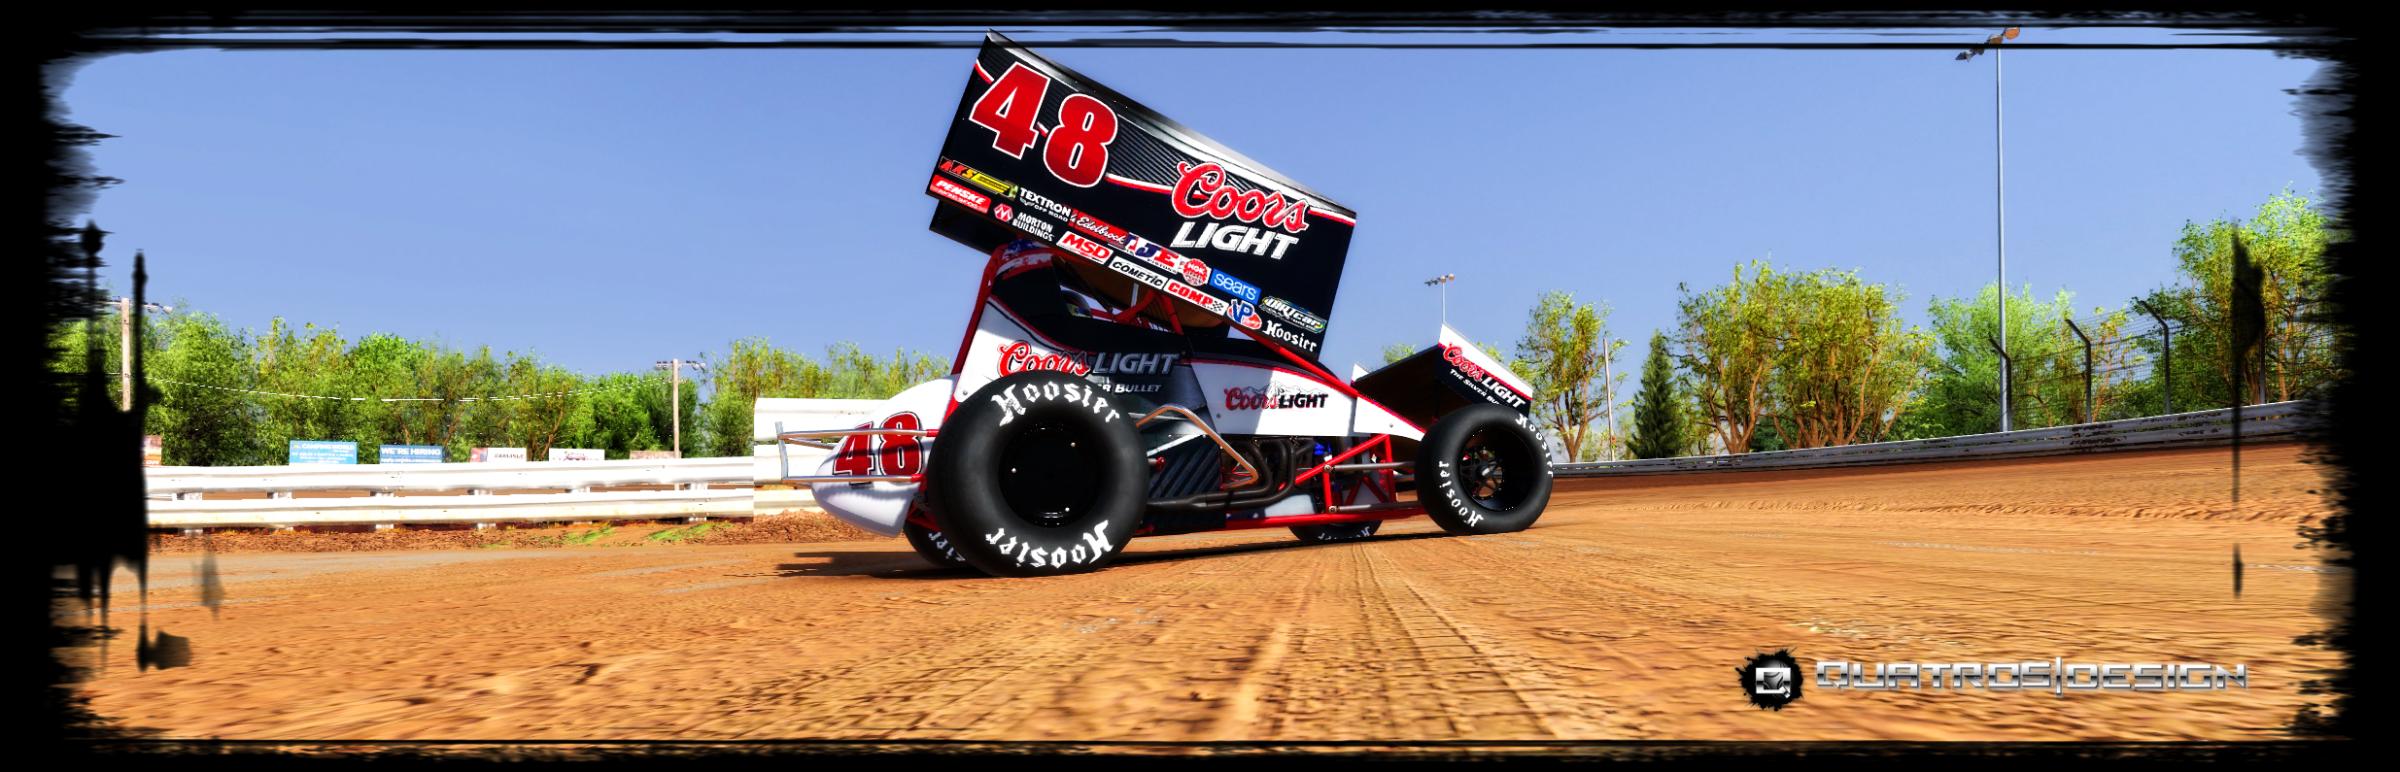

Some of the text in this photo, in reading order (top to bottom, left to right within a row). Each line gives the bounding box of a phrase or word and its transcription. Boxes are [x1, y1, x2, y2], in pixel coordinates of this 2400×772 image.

[968, 60, 1118, 188] 48
[936, 180, 986, 204] PENSKE
[1020, 187, 1072, 217] TEXTRON
[1172, 160, 1309, 233] Coors
[1012, 219, 1055, 242] BUILDINGS
[1018, 212, 1053, 232] MORTON
[1076, 214, 1126, 245] Edelbrock
[1062, 233, 1111, 260] MSD
[1170, 221, 1300, 260] LIGHT
[1168, 281, 1213, 307] COMP
[1213, 273, 1256, 301] sears
[1231, 300, 1254, 324] VP
[1262, 320, 1317, 352] Hoosier
[998, 340, 1180, 377] Coors LIGHT
[1115, 384, 1162, 393] BULLET
[1443, 342, 1526, 408] Coors LIGHT
[991, 381, 1120, 427] Hoosier
[1224, 386, 1328, 411] Coors LIGHT
[832, 410, 923, 486] 48
[1515, 413, 1553, 478] Hoosier
[1439, 461, 1484, 527] Hoosier
[986, 520, 1114, 568] Hoosier
